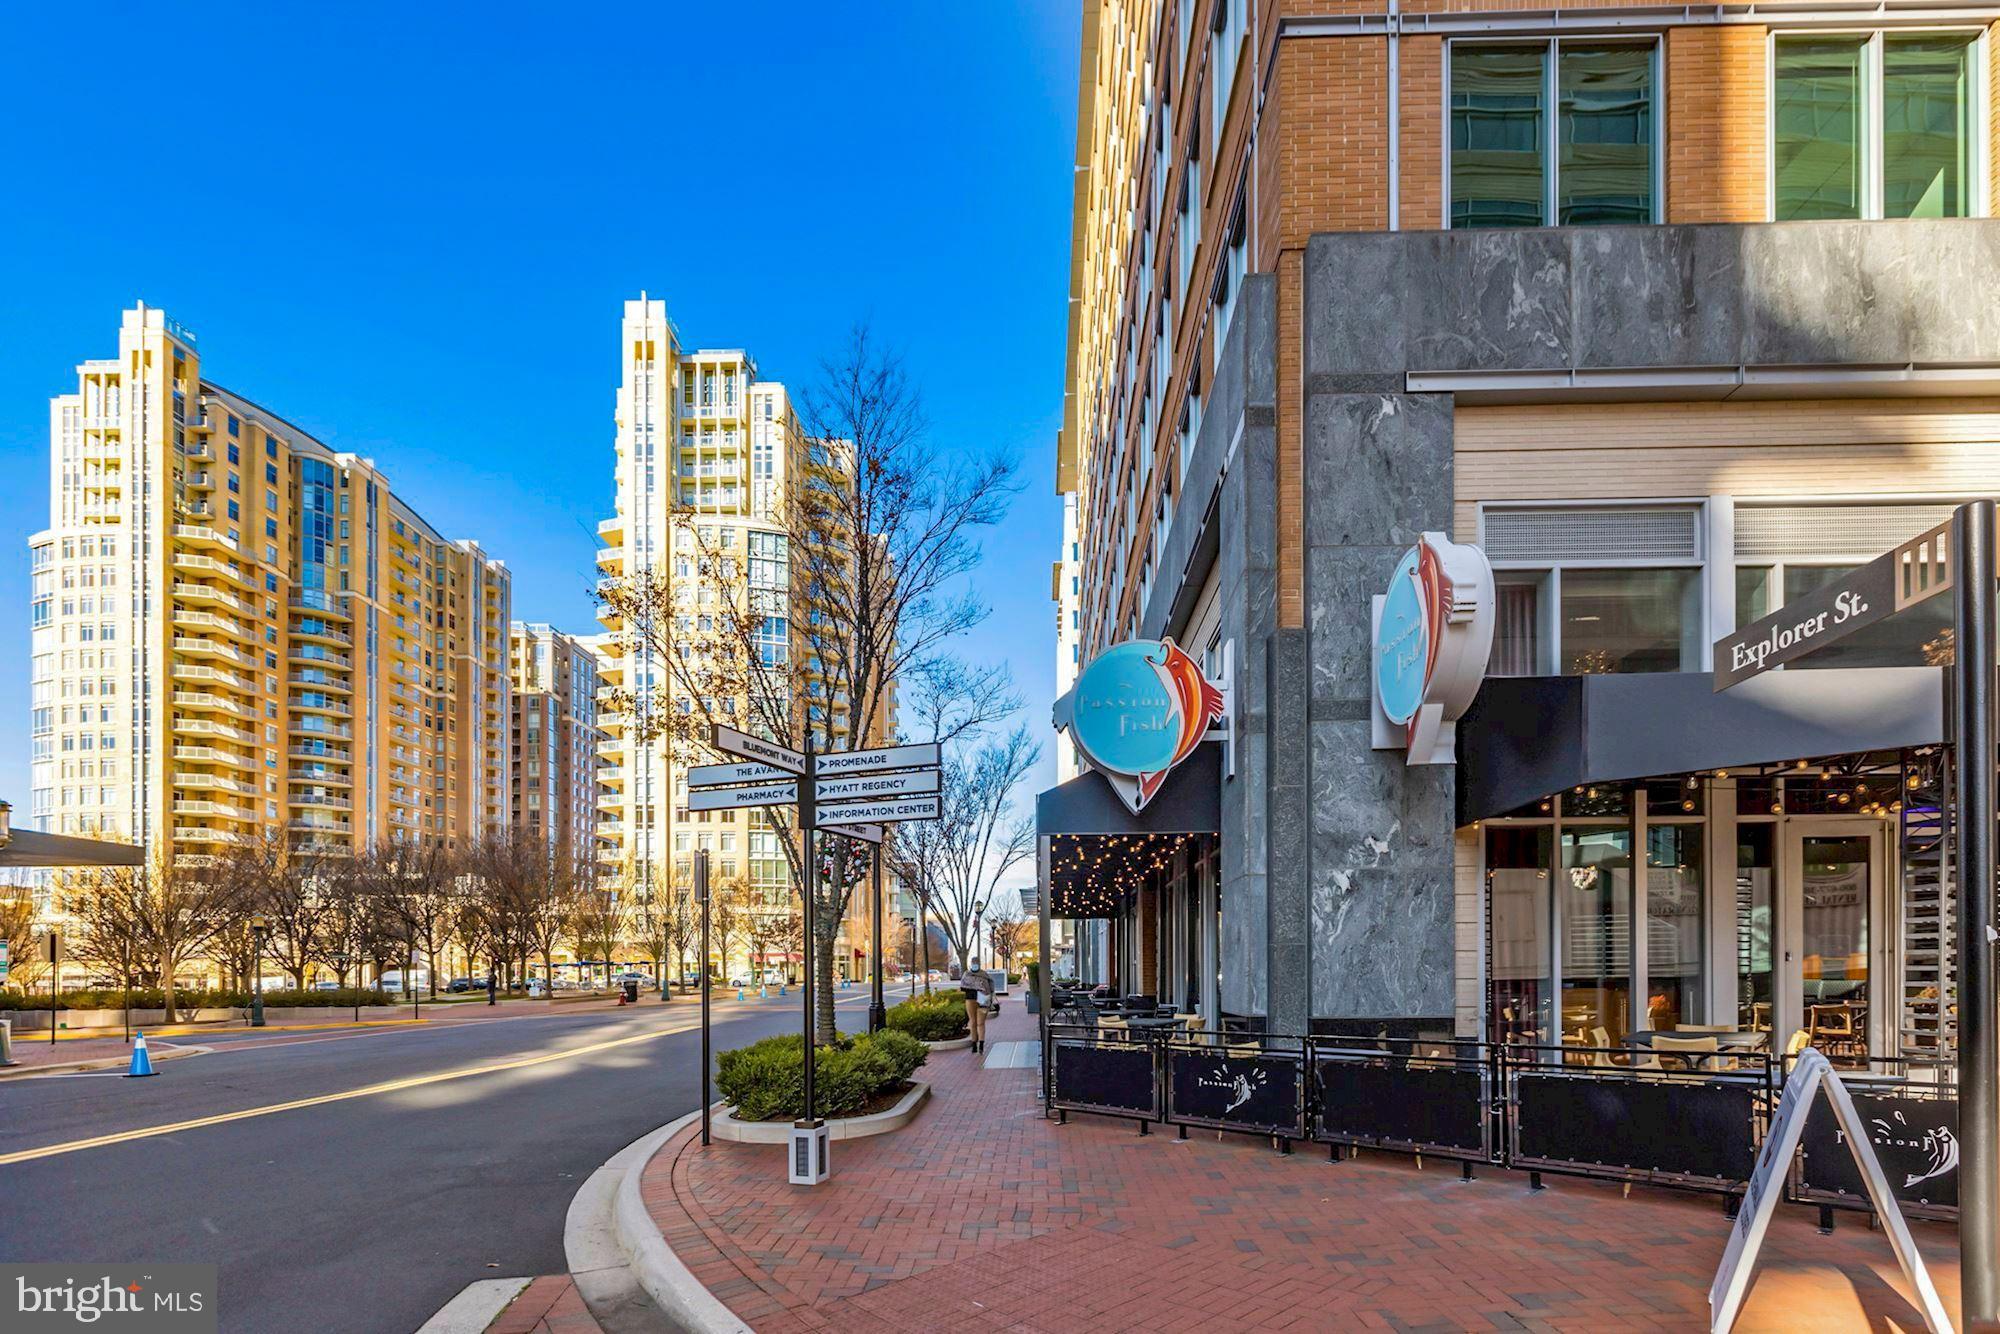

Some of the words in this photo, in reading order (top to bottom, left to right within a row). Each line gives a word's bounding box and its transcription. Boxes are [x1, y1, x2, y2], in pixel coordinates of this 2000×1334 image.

[1731, 611, 1828, 672] Explorer
[1834, 590, 1869, 624] St.
[1080, 695, 1166, 716] Passion
[1120, 714, 1164, 738] Fish
[742, 740, 780, 760] BLUEMONT
[781, 752, 797, 765] WAY
[829, 755, 887, 768] PROMENADE
[736, 767, 753, 777] THE
[829, 783, 860, 794] HYATT
[861, 779, 906, 791] REGENCY
[736, 790, 784, 801] PHARMACY
[829, 807, 894, 819] INFORMATION
[897, 803, 935, 814] CENTER
